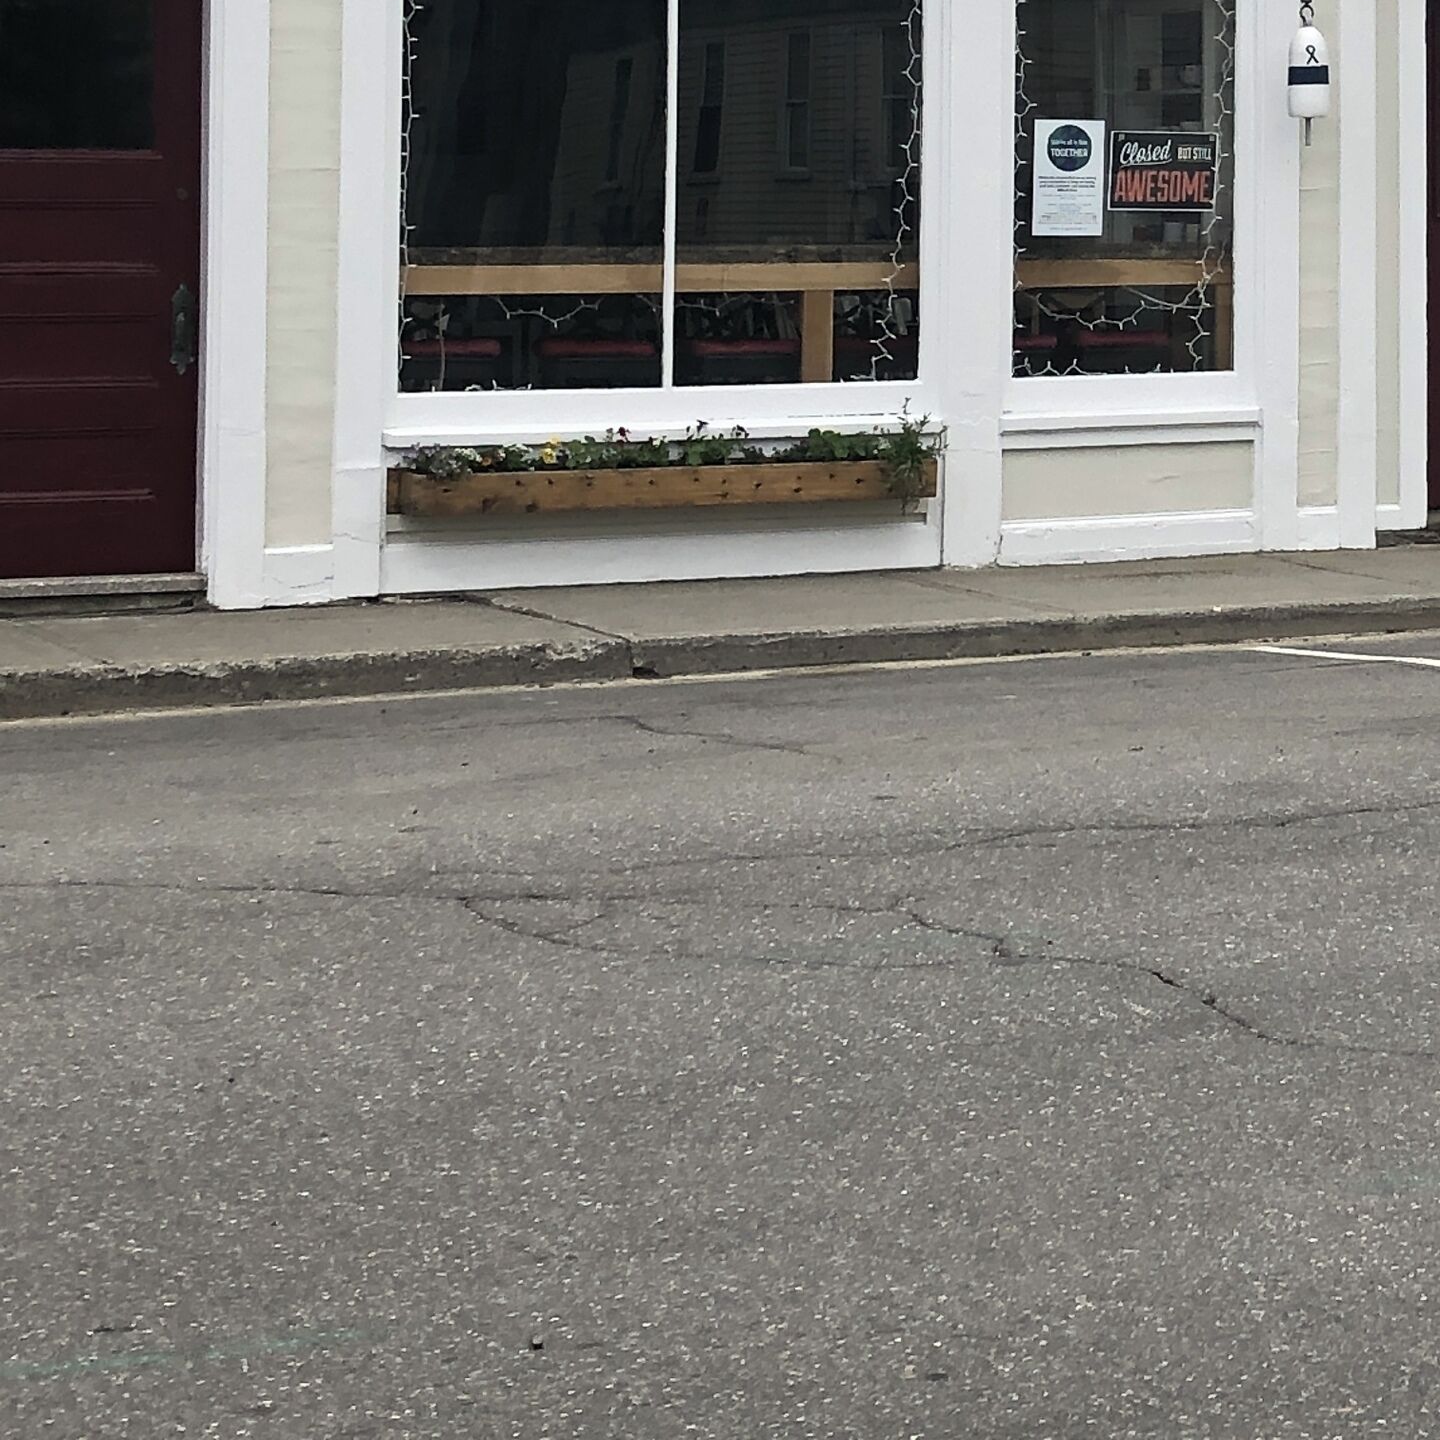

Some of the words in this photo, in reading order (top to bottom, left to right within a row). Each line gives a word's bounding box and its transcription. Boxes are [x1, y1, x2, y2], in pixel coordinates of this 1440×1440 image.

[1119, 138, 1173, 166] Closed
[1177, 146, 1193, 160] BUT
[1192, 146, 1212, 160] STILL
[1114, 169, 1211, 203] AWESOME
